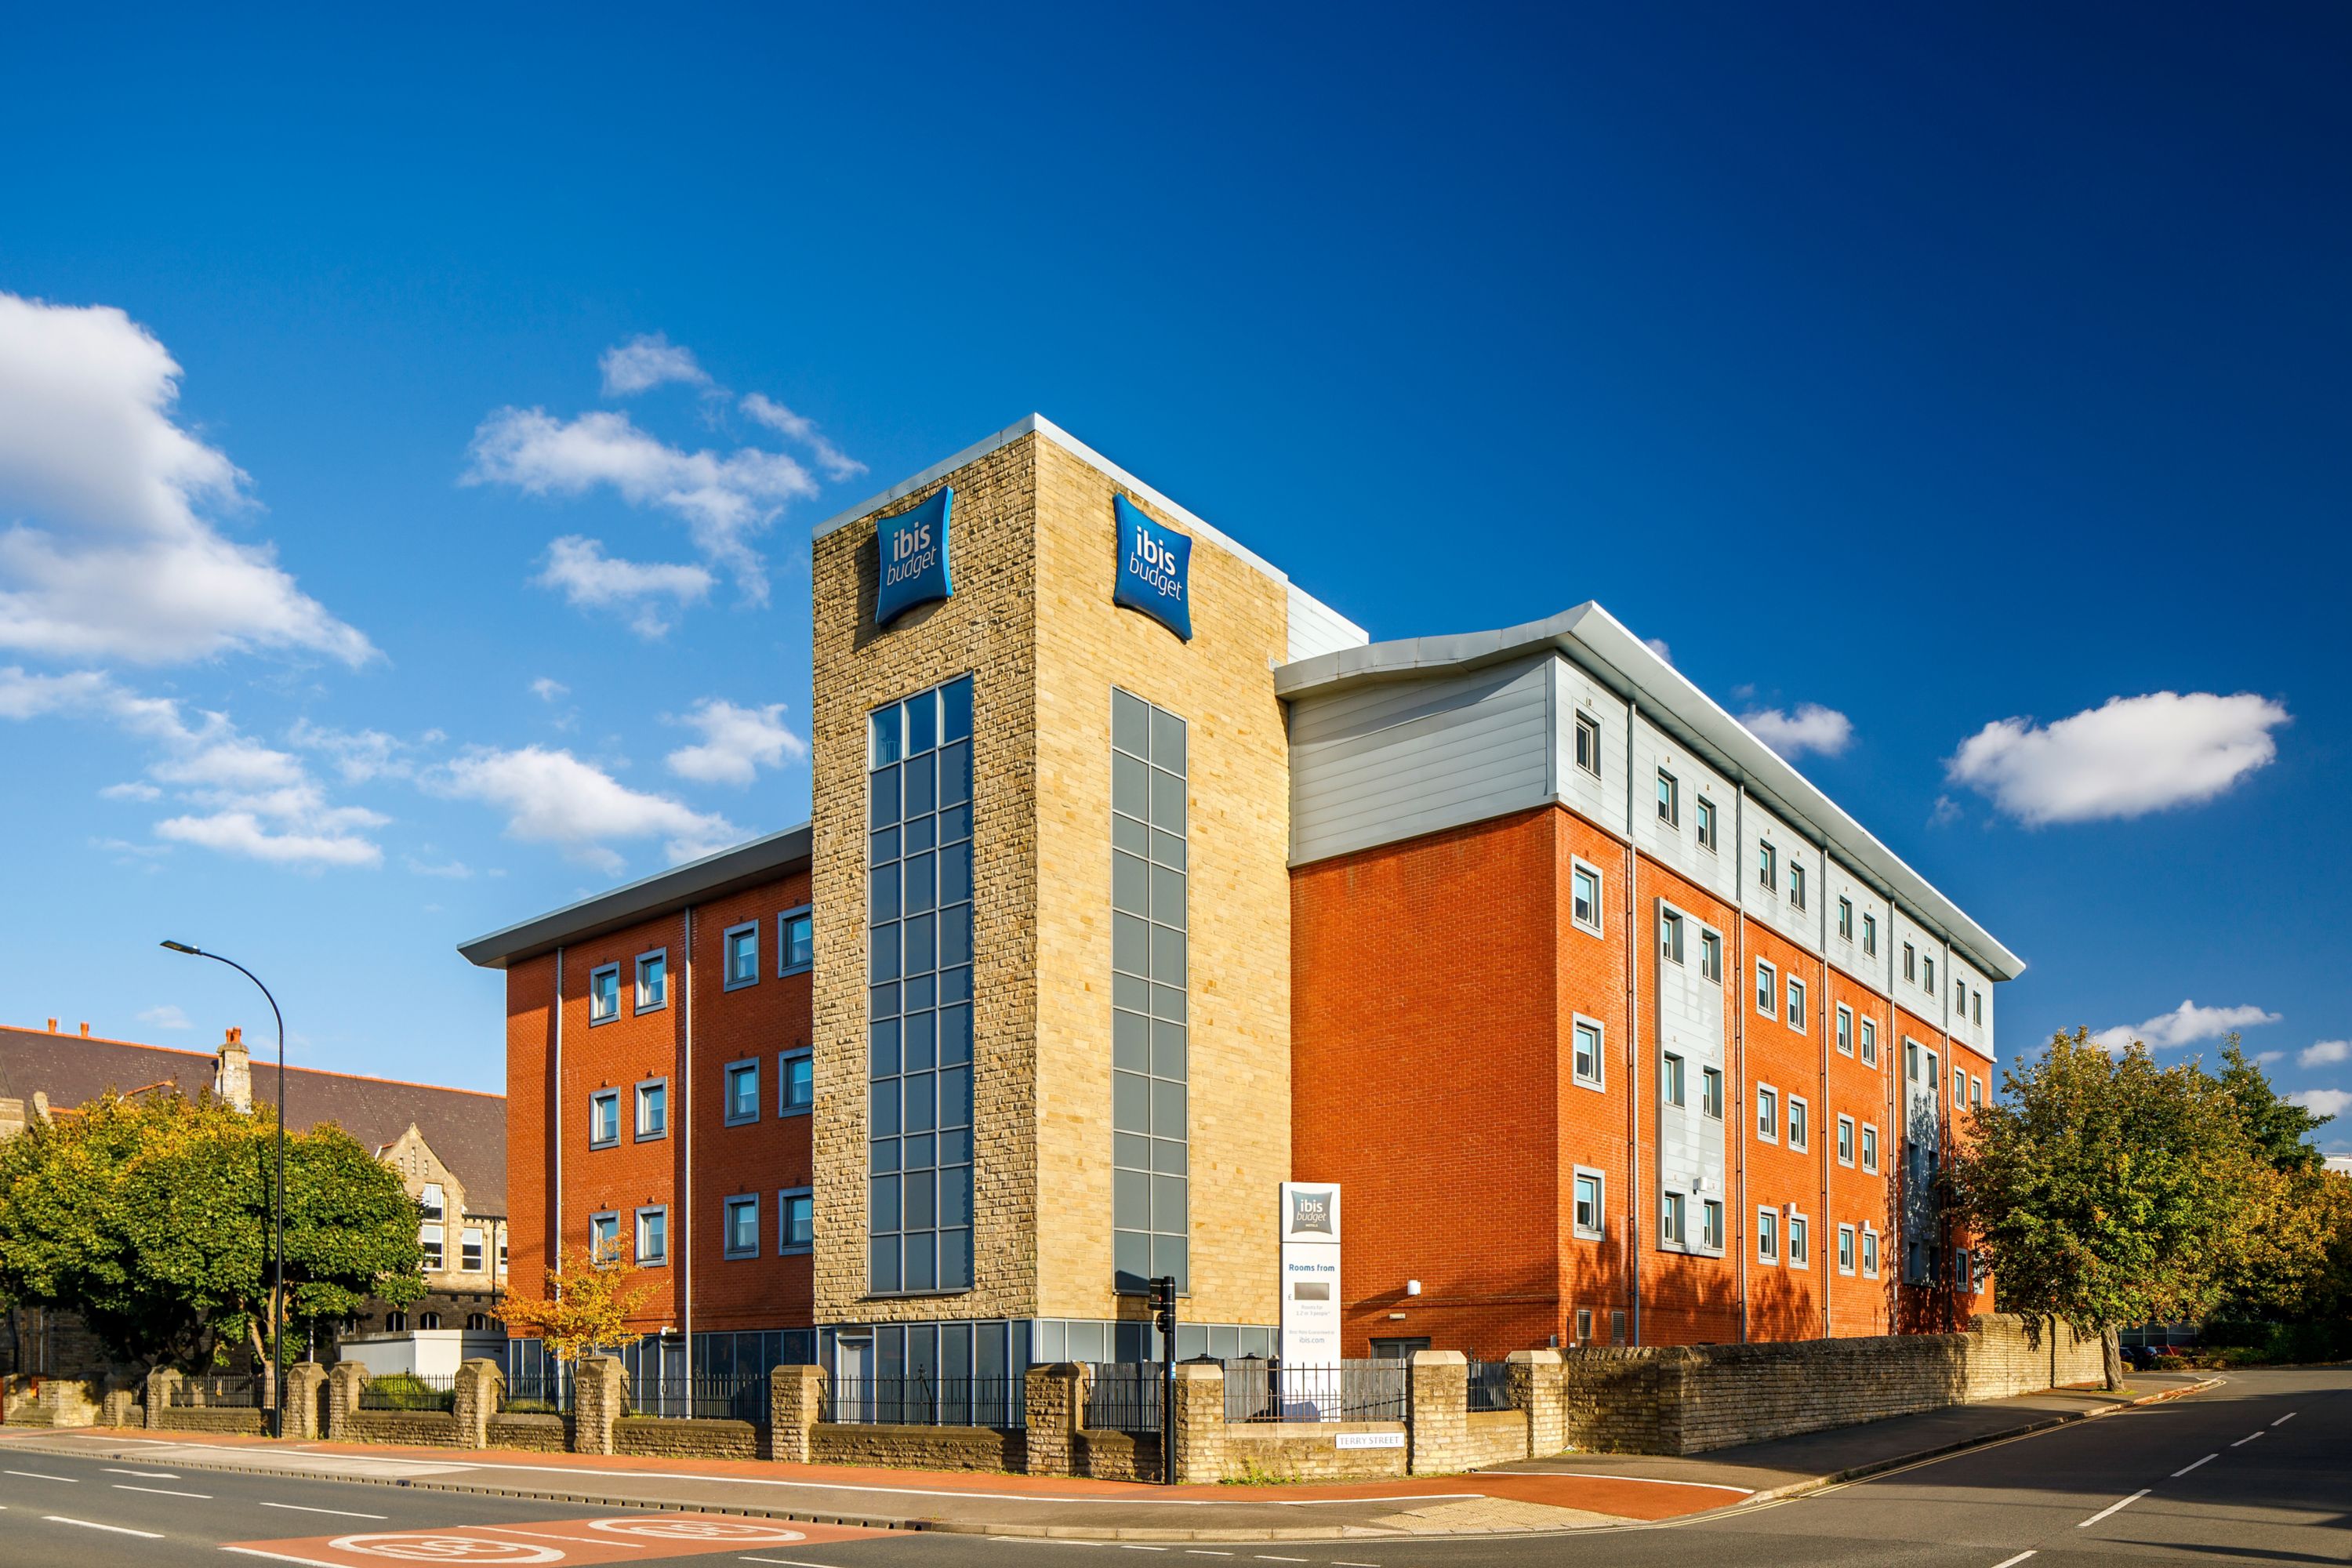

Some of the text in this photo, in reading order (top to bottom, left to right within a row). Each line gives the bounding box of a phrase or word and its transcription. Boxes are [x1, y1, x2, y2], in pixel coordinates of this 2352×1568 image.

[894, 521, 931, 562] ibis
[1137, 524, 1176, 575] ibis
[887, 546, 937, 586] budget
[1129, 551, 1182, 601] budget
[1301, 1200, 1323, 1213] ibis
[1297, 1211, 1327, 1223] budget
[1368, 1436, 1399, 1444] STREET
[630, 1522, 758, 1537] 30
[371, 1540, 518, 1556] 30
